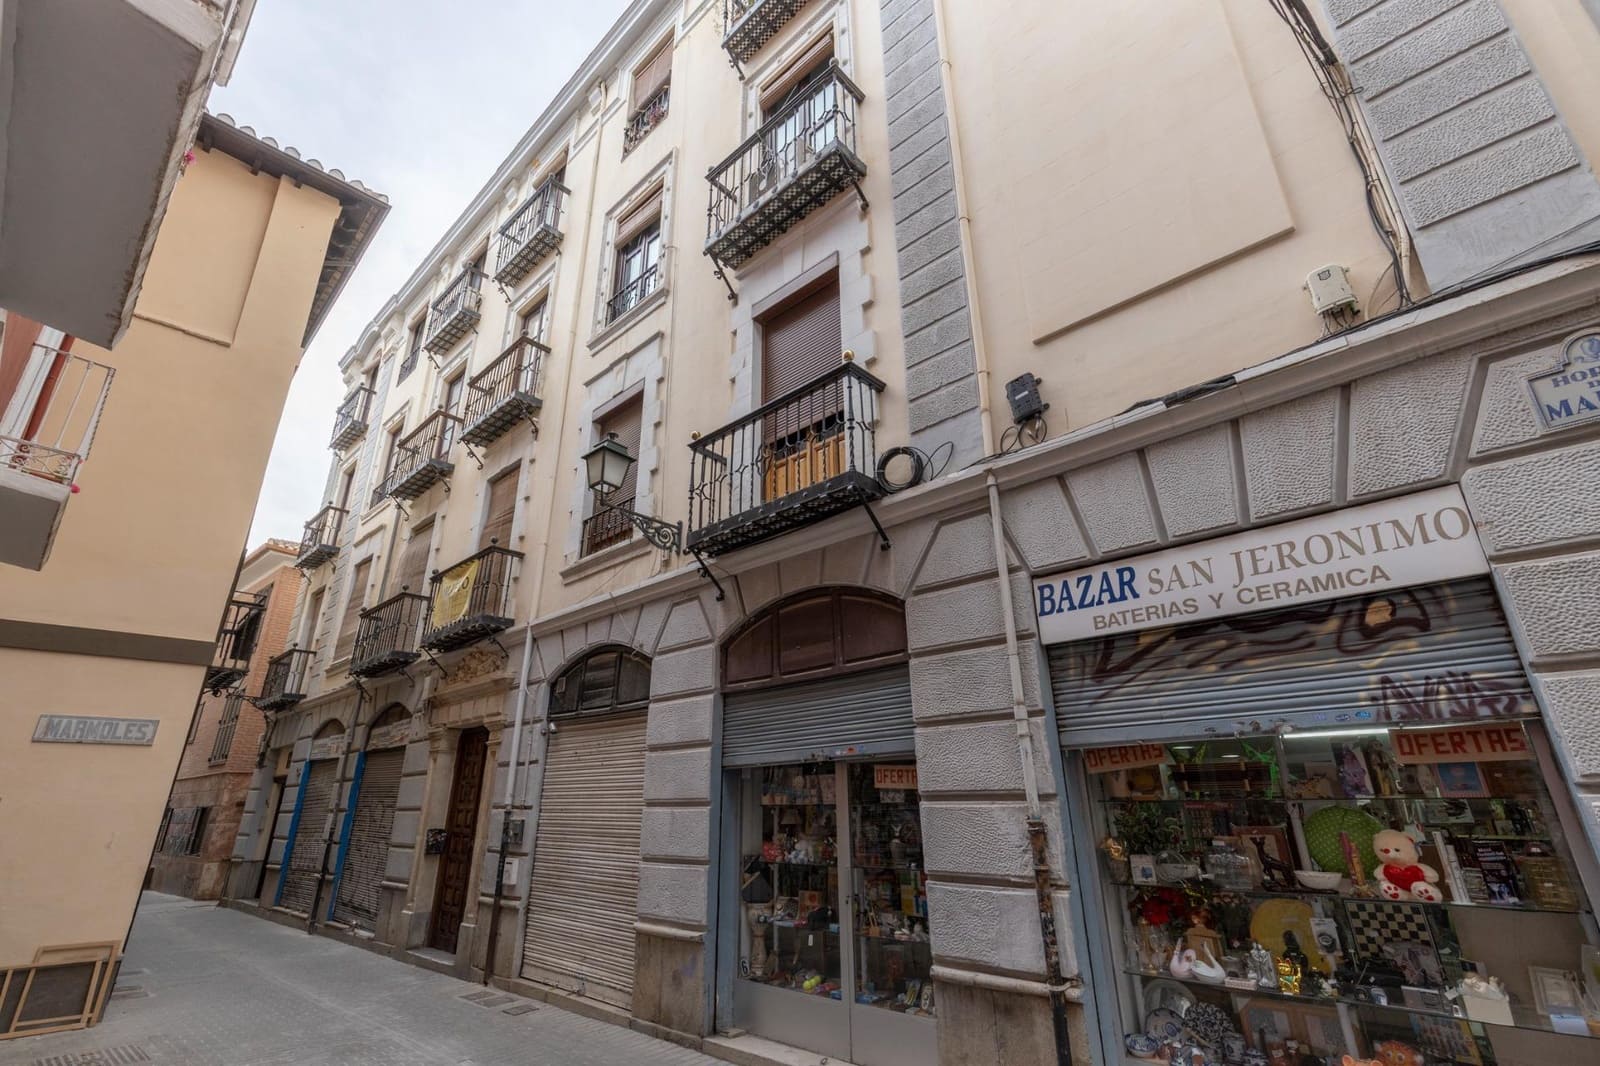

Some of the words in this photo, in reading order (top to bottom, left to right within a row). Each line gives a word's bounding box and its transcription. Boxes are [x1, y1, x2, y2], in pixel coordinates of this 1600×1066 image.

[1546, 390, 1600, 421] MA
[1038, 566, 1140, 617] BAZAR
[1147, 557, 1216, 596] SAN
[1229, 506, 1471, 588] JERONIMO
[1093, 597, 1200, 631] BATERIAS
[1208, 592, 1226, 610] Y
[1236, 565, 1392, 606] CERAMICA
[45, 718, 149, 741] MARMOLES
[1396, 728, 1528, 757] OFERTAS
[1085, 743, 1164, 768] OFERTAS
